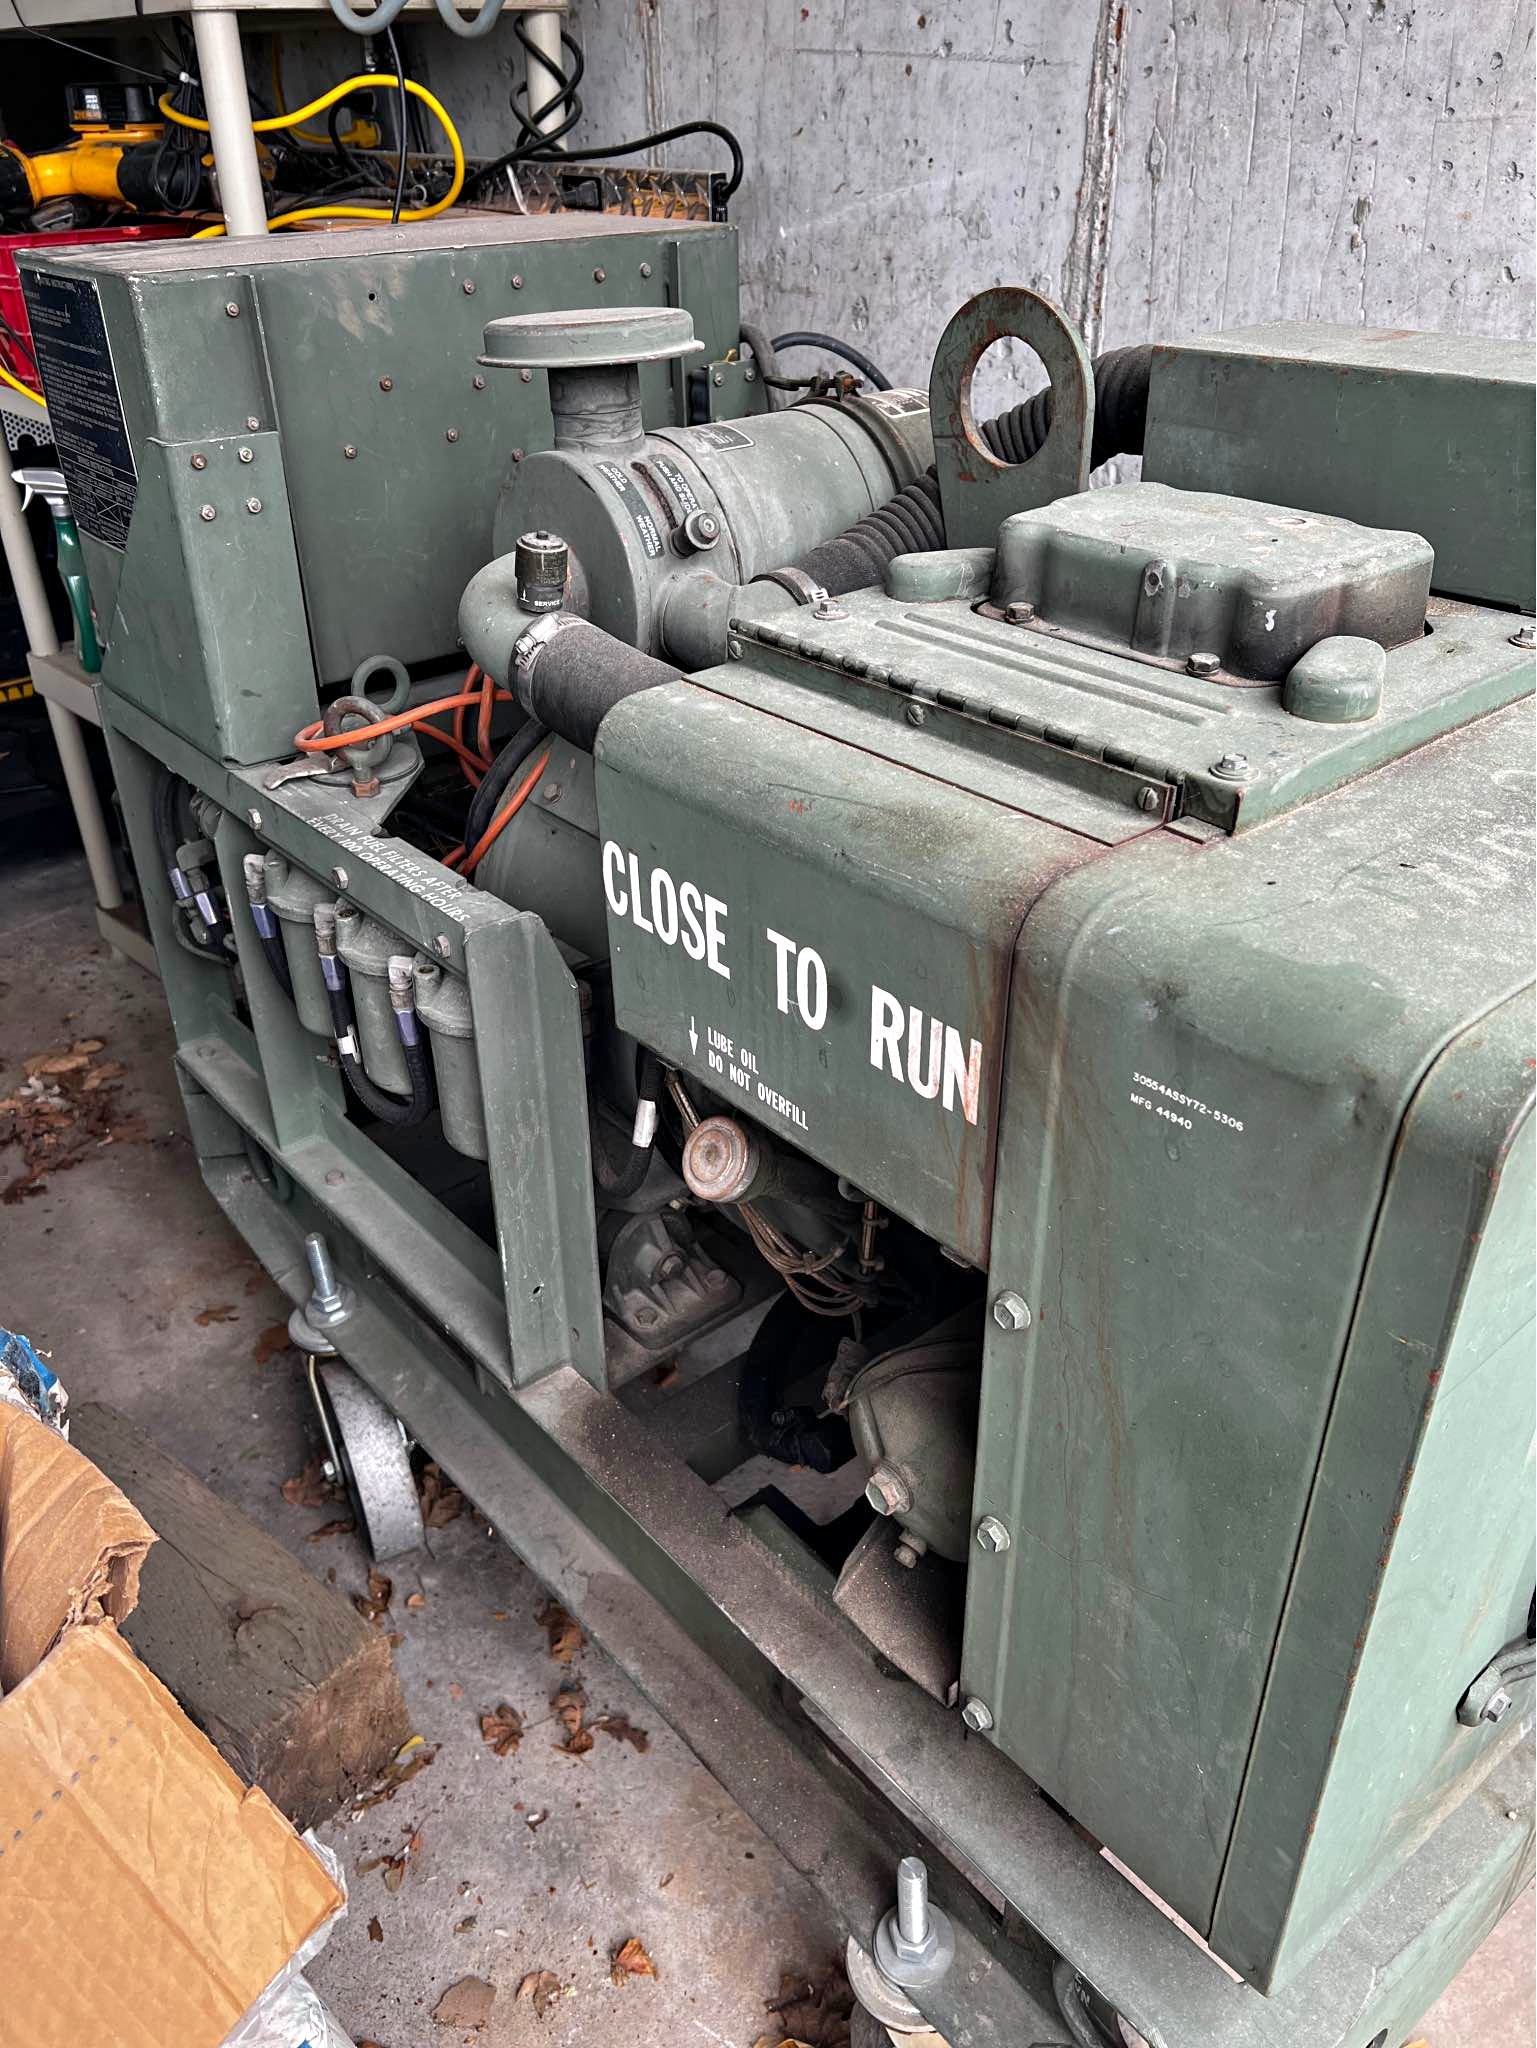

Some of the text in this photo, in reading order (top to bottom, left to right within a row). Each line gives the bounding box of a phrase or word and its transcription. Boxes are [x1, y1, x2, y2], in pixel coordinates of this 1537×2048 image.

[610, 467, 628, 484] COLD
[656, 460, 673, 477] PUSH
[669, 477, 682, 492] AND
[674, 473, 684, 483] TO
[636, 514, 656, 557] WEATHER
[643, 515, 662, 552] NORMAL
[306, 817, 473, 922] EVERY 100 OPERATING HOURS
[322, 813, 464, 900] DRAIN FUEL FILTERS AFTER
[602, 840, 983, 1127] CLOSE TO RUN
[707, 1026, 760, 1075] LUBE OIL
[708, 1049, 809, 1131] DO NOT OVERFILL
[1130, 1093, 1193, 1130] MFG 44940
[1132, 1071, 1244, 1132] 30554ASSY72-5306
